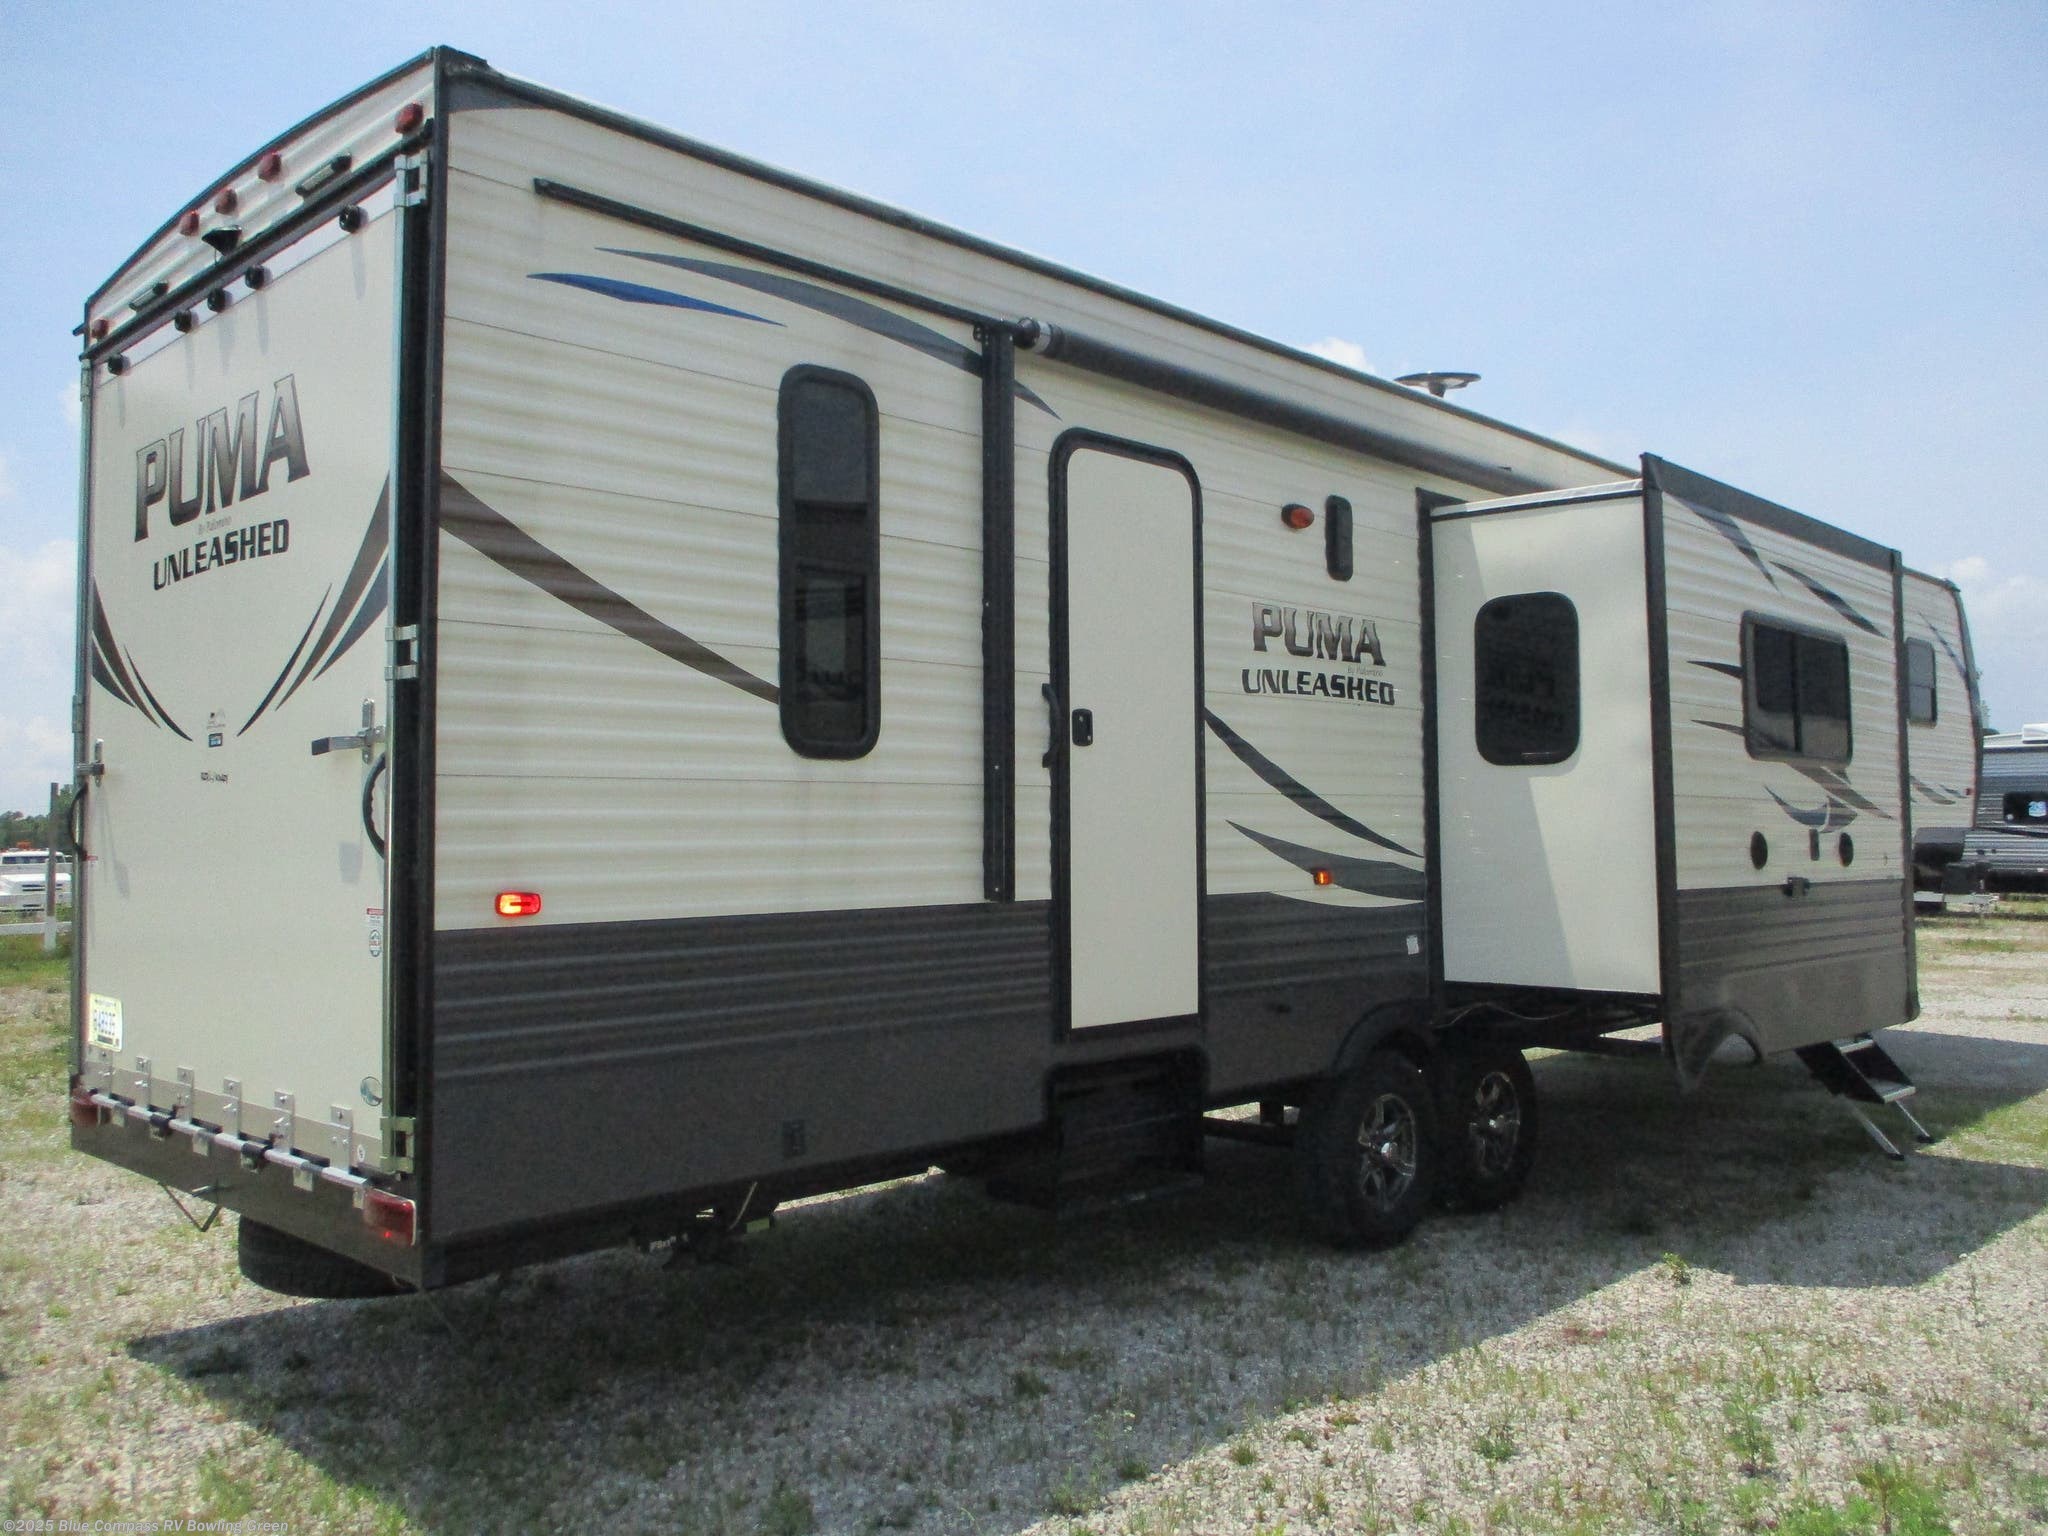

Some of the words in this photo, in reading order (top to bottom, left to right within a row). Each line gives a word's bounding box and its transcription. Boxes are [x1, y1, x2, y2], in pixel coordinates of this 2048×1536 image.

[135, 374, 310, 542] PUMA
[153, 519, 289, 590] UNLEASHED
[1252, 602, 1386, 666] PUMA
[1242, 669, 1395, 705] UNLEASHED
